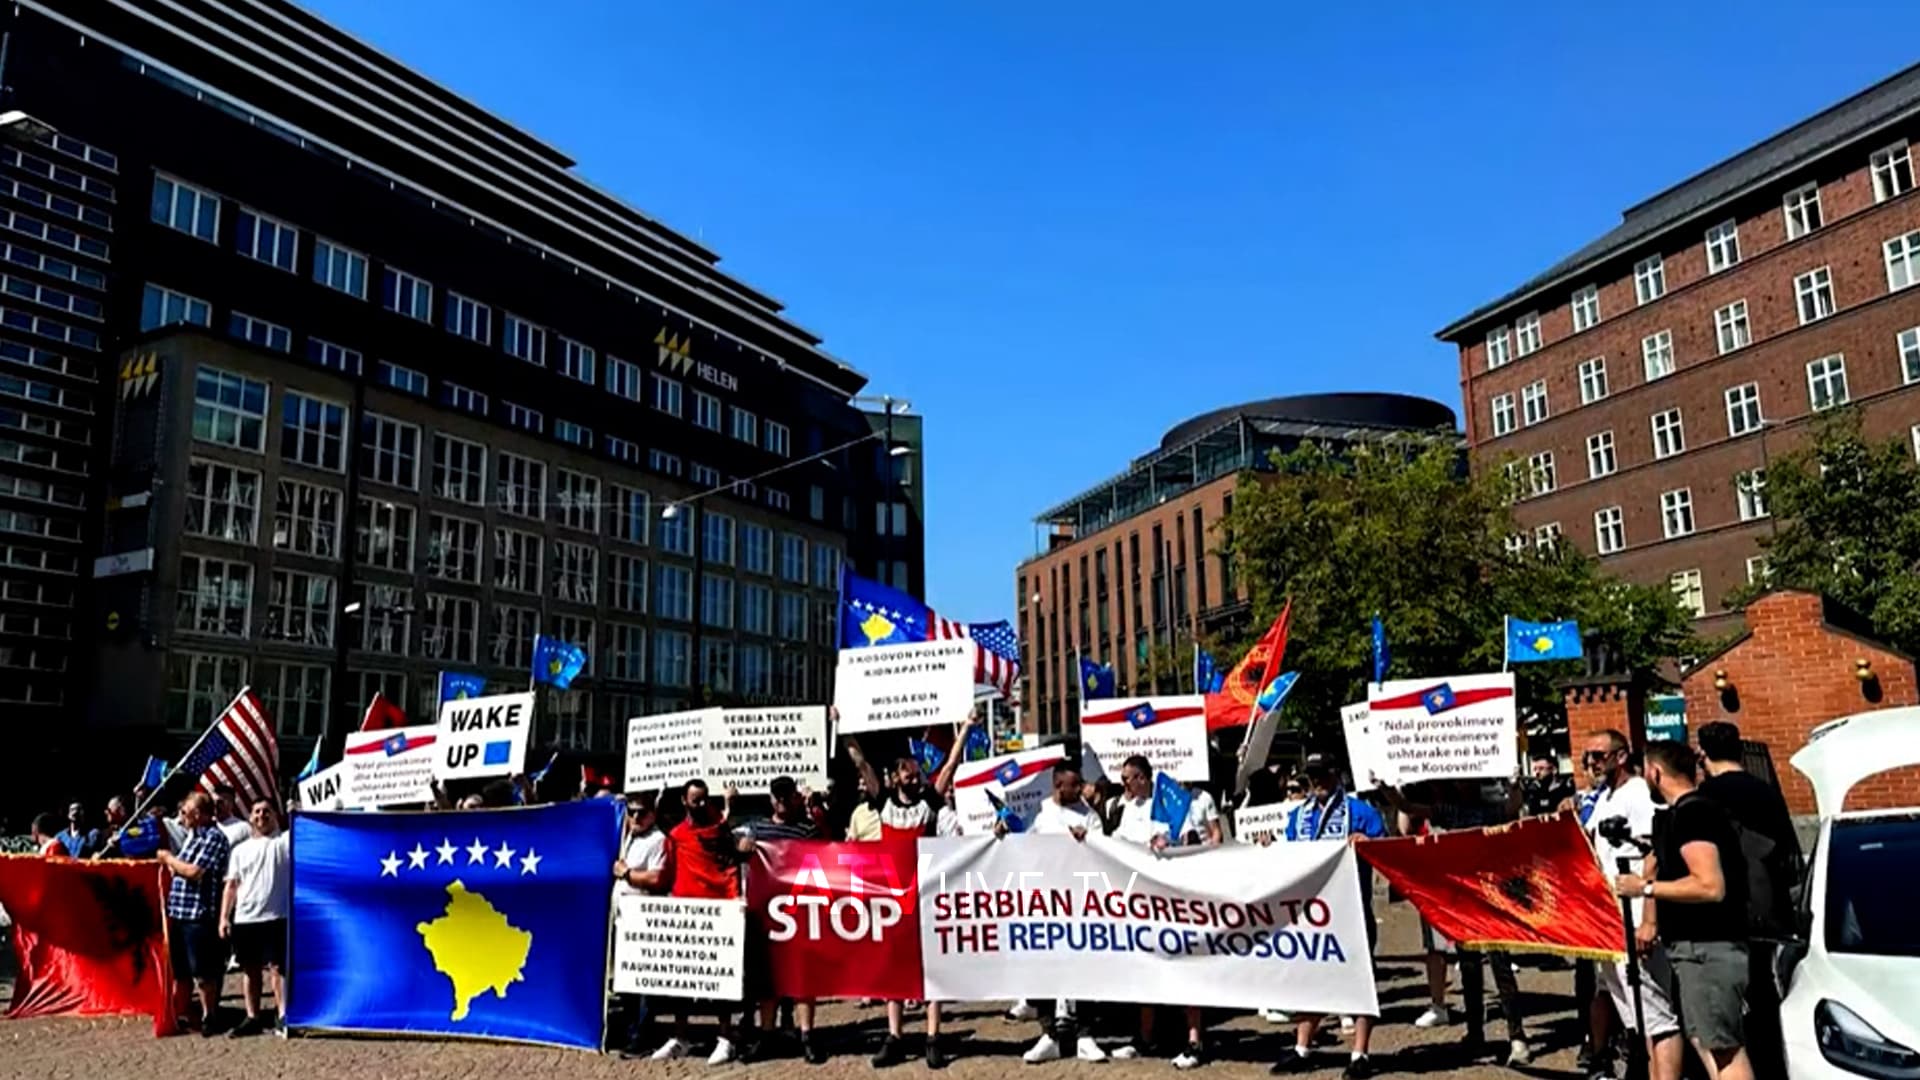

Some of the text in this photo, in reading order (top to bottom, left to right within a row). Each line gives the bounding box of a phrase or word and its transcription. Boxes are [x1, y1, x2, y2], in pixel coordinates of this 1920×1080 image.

[697, 361, 738, 392] HELEN
[856, 651, 913, 664] KOSOVON
[451, 704, 523, 733] WAKE
[723, 712, 802, 724] SERBIA TUKEE
[1416, 716, 1504, 731] provokimeve
[783, 725, 796, 734] JA
[710, 740, 757, 750] SERBIAN
[1142, 736, 1176, 747] akteve
[1387, 734, 1411, 745] dhe
[446, 743, 479, 769] UP
[727, 753, 742, 763] YLI
[1387, 746, 1450, 760] ushtarake
[1399, 764, 1419, 773] me
[1239, 812, 1283, 825] POHJOIS
[640, 903, 722, 917] SERBIA TUKEE
[767, 888, 1331, 942] STOP SERBIAN AGGRESION TO
[700, 921, 714, 931] JA
[624, 931, 673, 943] SERBIAN
[934, 922, 1346, 963] THE REPUBLIC OF KOSOVA
[640, 948, 657, 958] YLI
